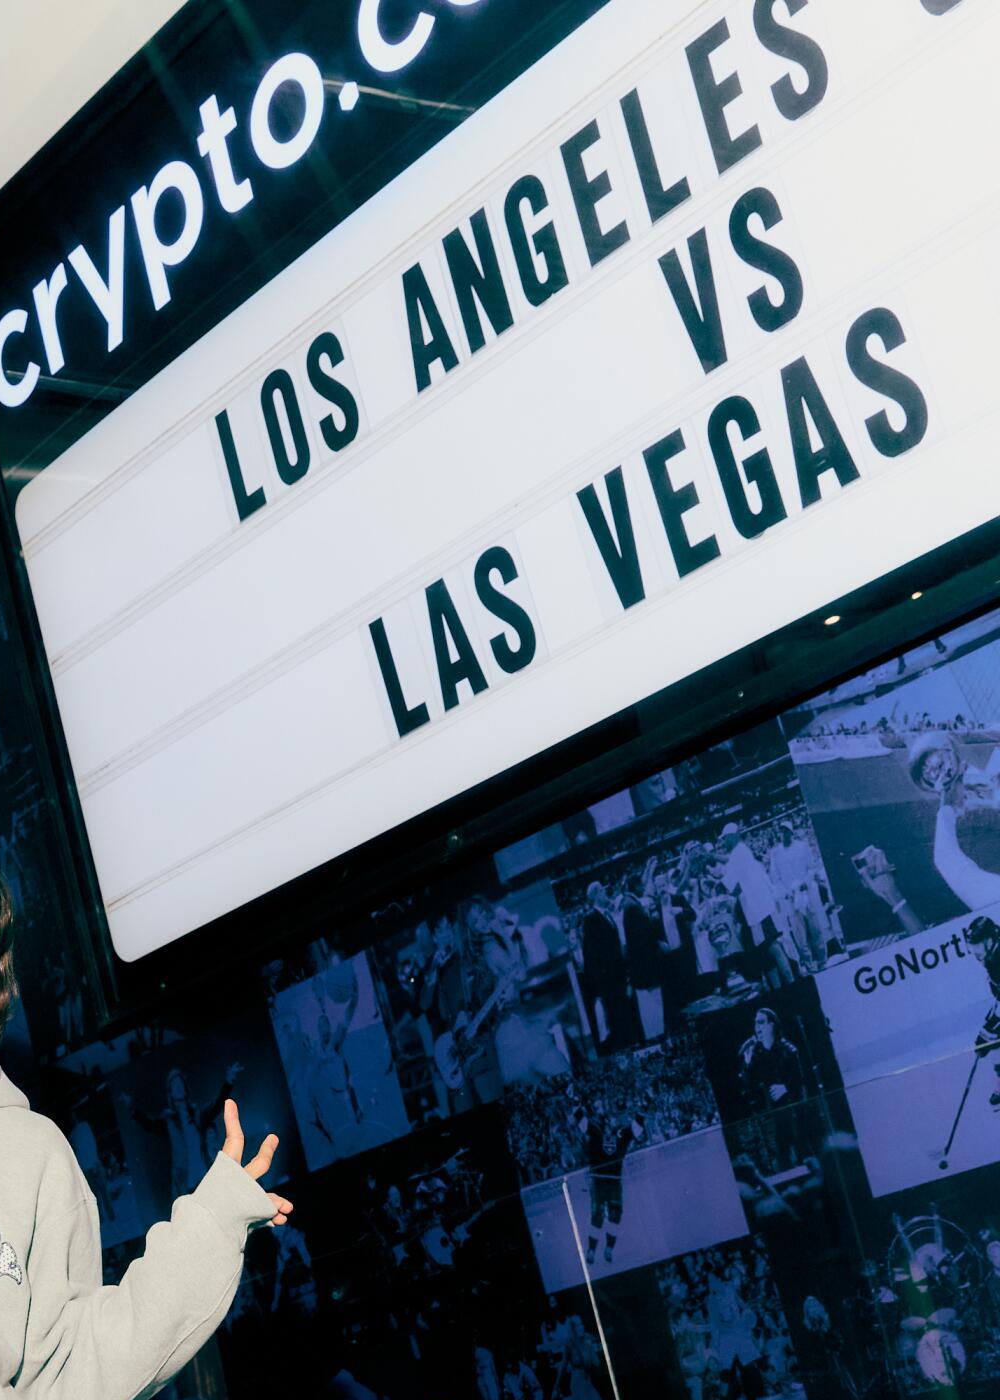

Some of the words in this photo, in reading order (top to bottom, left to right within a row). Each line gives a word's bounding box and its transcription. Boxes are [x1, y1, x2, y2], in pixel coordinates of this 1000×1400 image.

[214, 331, 360, 523] LOS
[401, 0, 828, 394] ANGELES
[657, 186, 804, 375] VS
[368, 545, 537, 740] LAS
[575, 307, 928, 611] VEGAS
